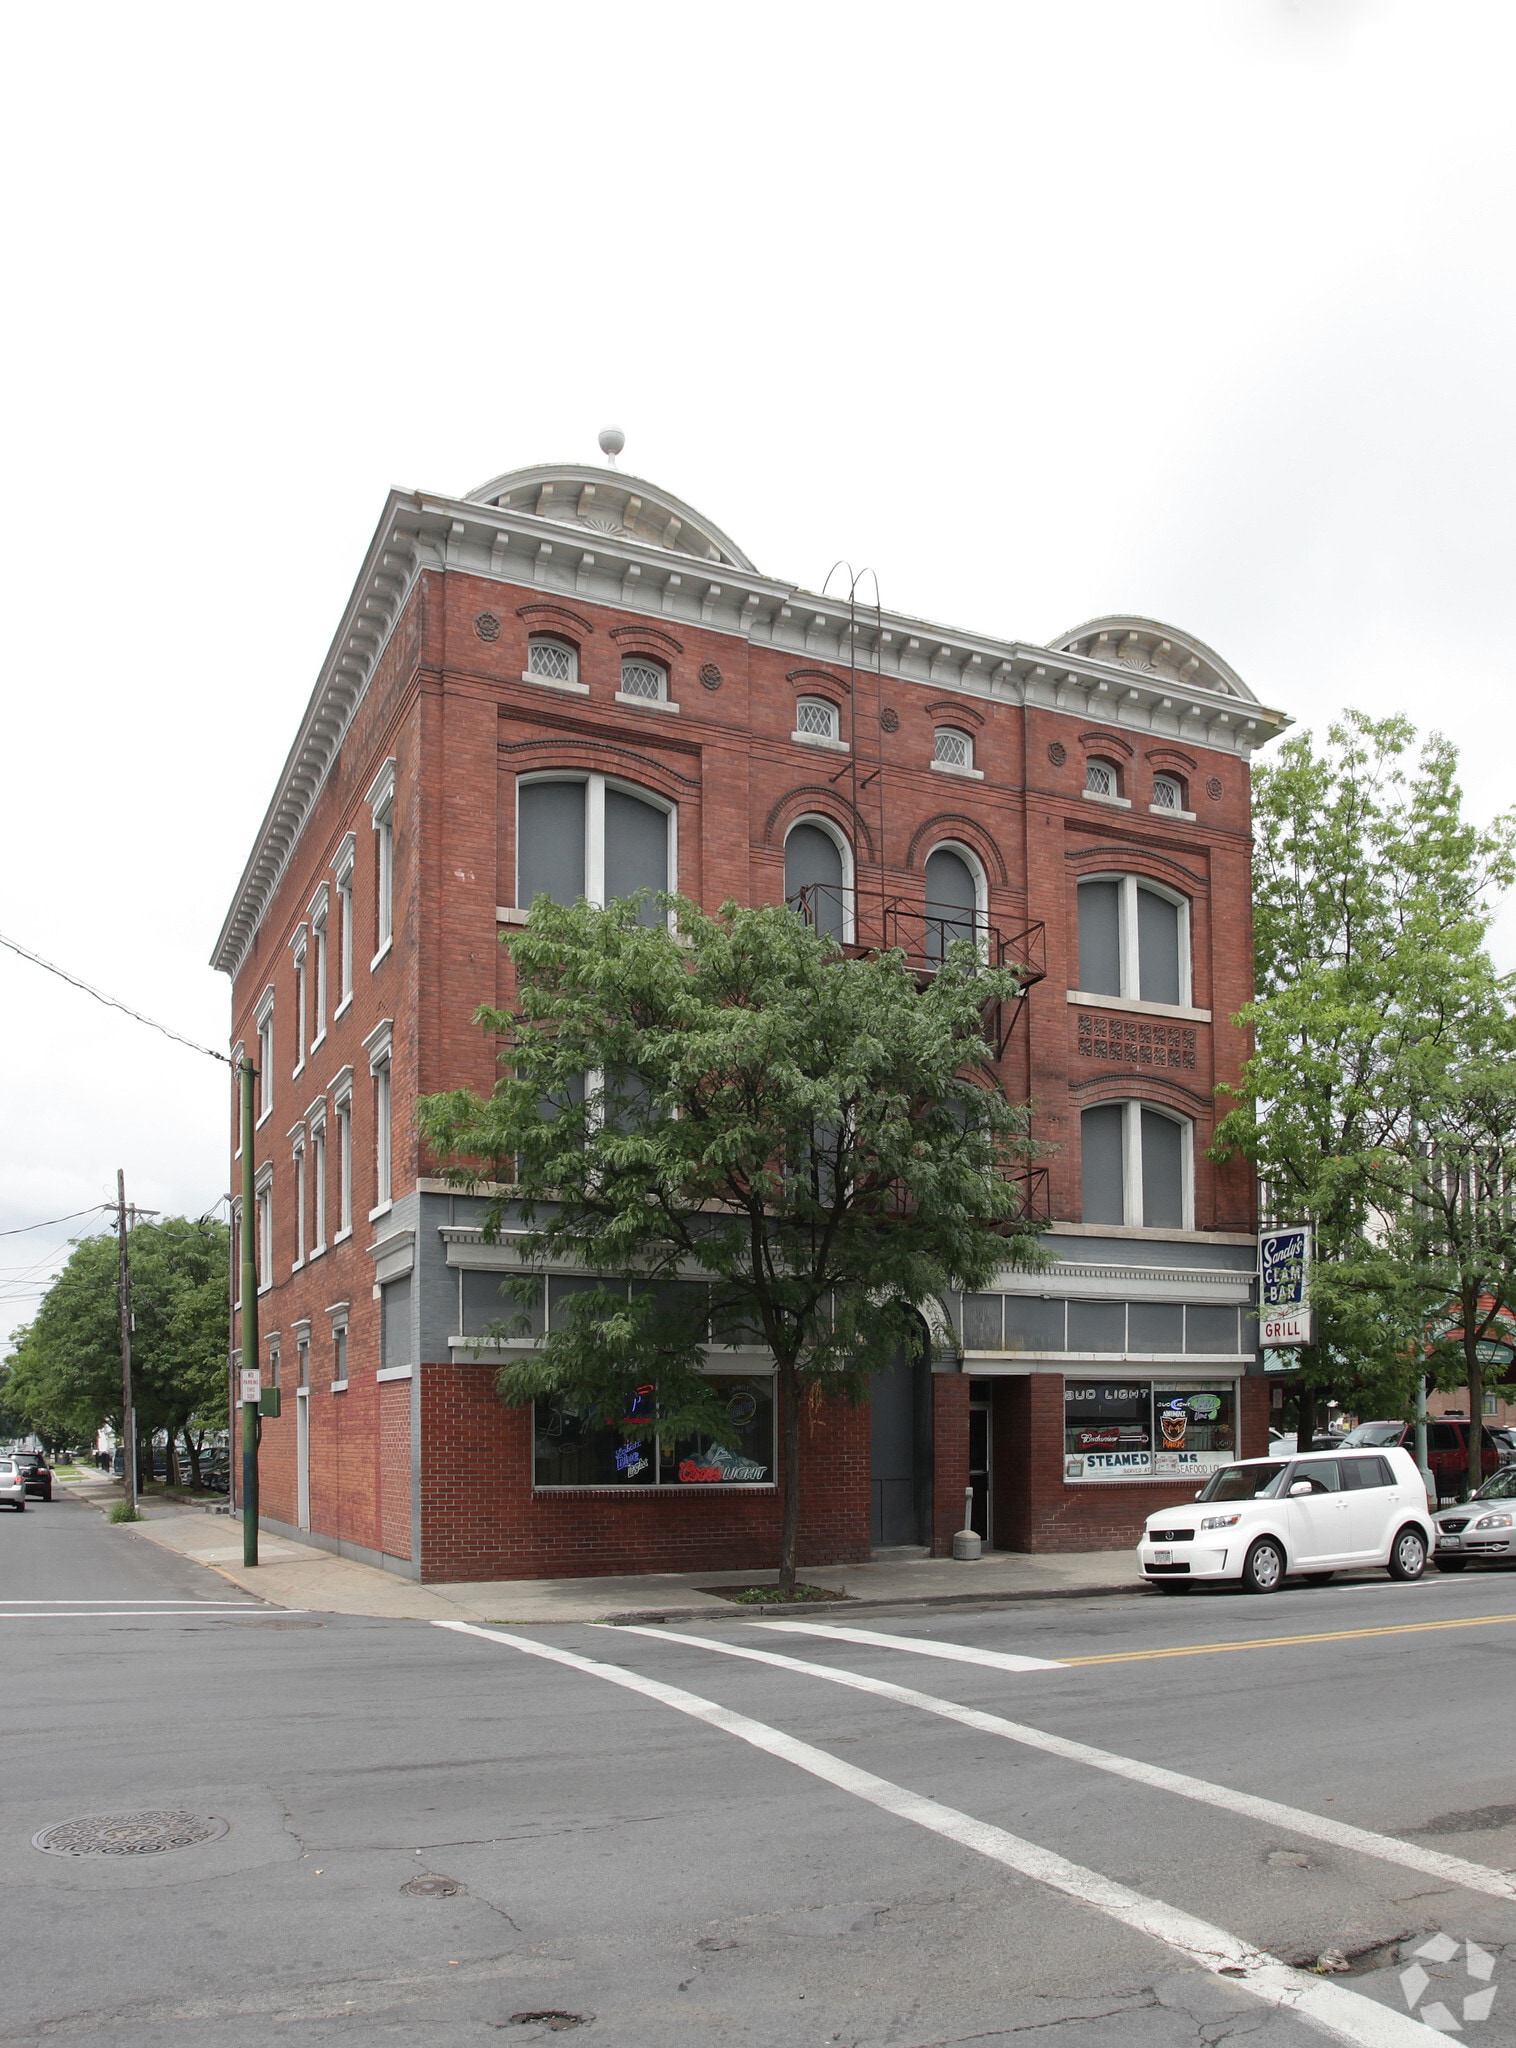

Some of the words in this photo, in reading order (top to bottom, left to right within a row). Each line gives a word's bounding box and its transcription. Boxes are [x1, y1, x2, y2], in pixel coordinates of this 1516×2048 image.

[1263, 1235, 1303, 1268] Sandy's
[1265, 1264, 1301, 1284] CLAM
[1270, 1284, 1295, 1301] BAR
[1265, 1321, 1300, 1337] GRILL
[1064, 1389, 1096, 1401] BUD
[1104, 1388, 1149, 1400] LIGHT
[1087, 1453, 1149, 1467] STEAMED
[679, 1460, 722, 1482] Coors
[722, 1466, 768, 1480] LIGHT
